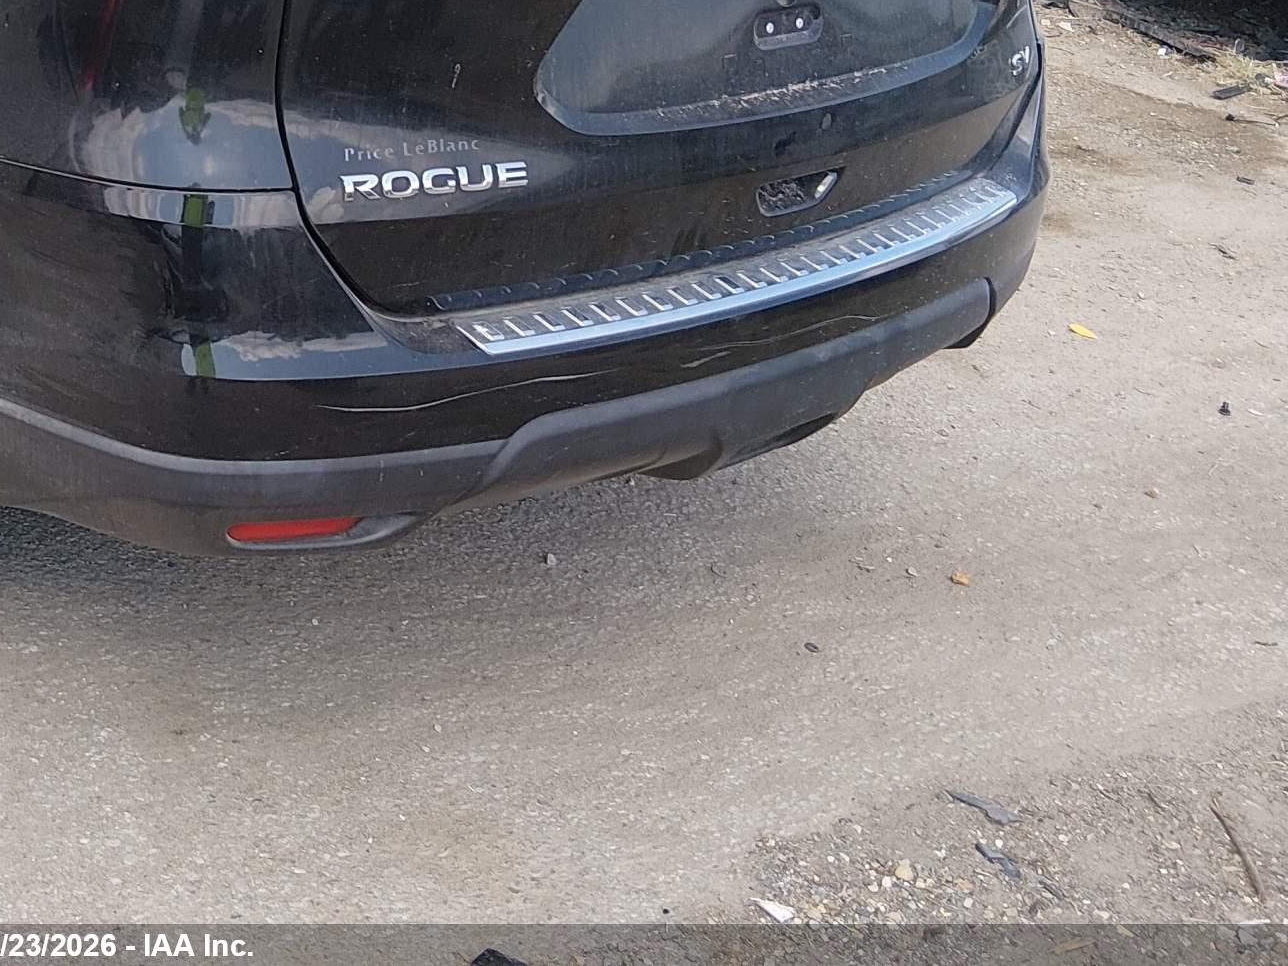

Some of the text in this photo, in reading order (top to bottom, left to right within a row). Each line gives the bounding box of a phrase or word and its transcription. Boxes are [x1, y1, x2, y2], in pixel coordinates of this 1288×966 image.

[344, 138, 480, 161] Price LeBlanc
[340, 161, 529, 202] ROGUE
